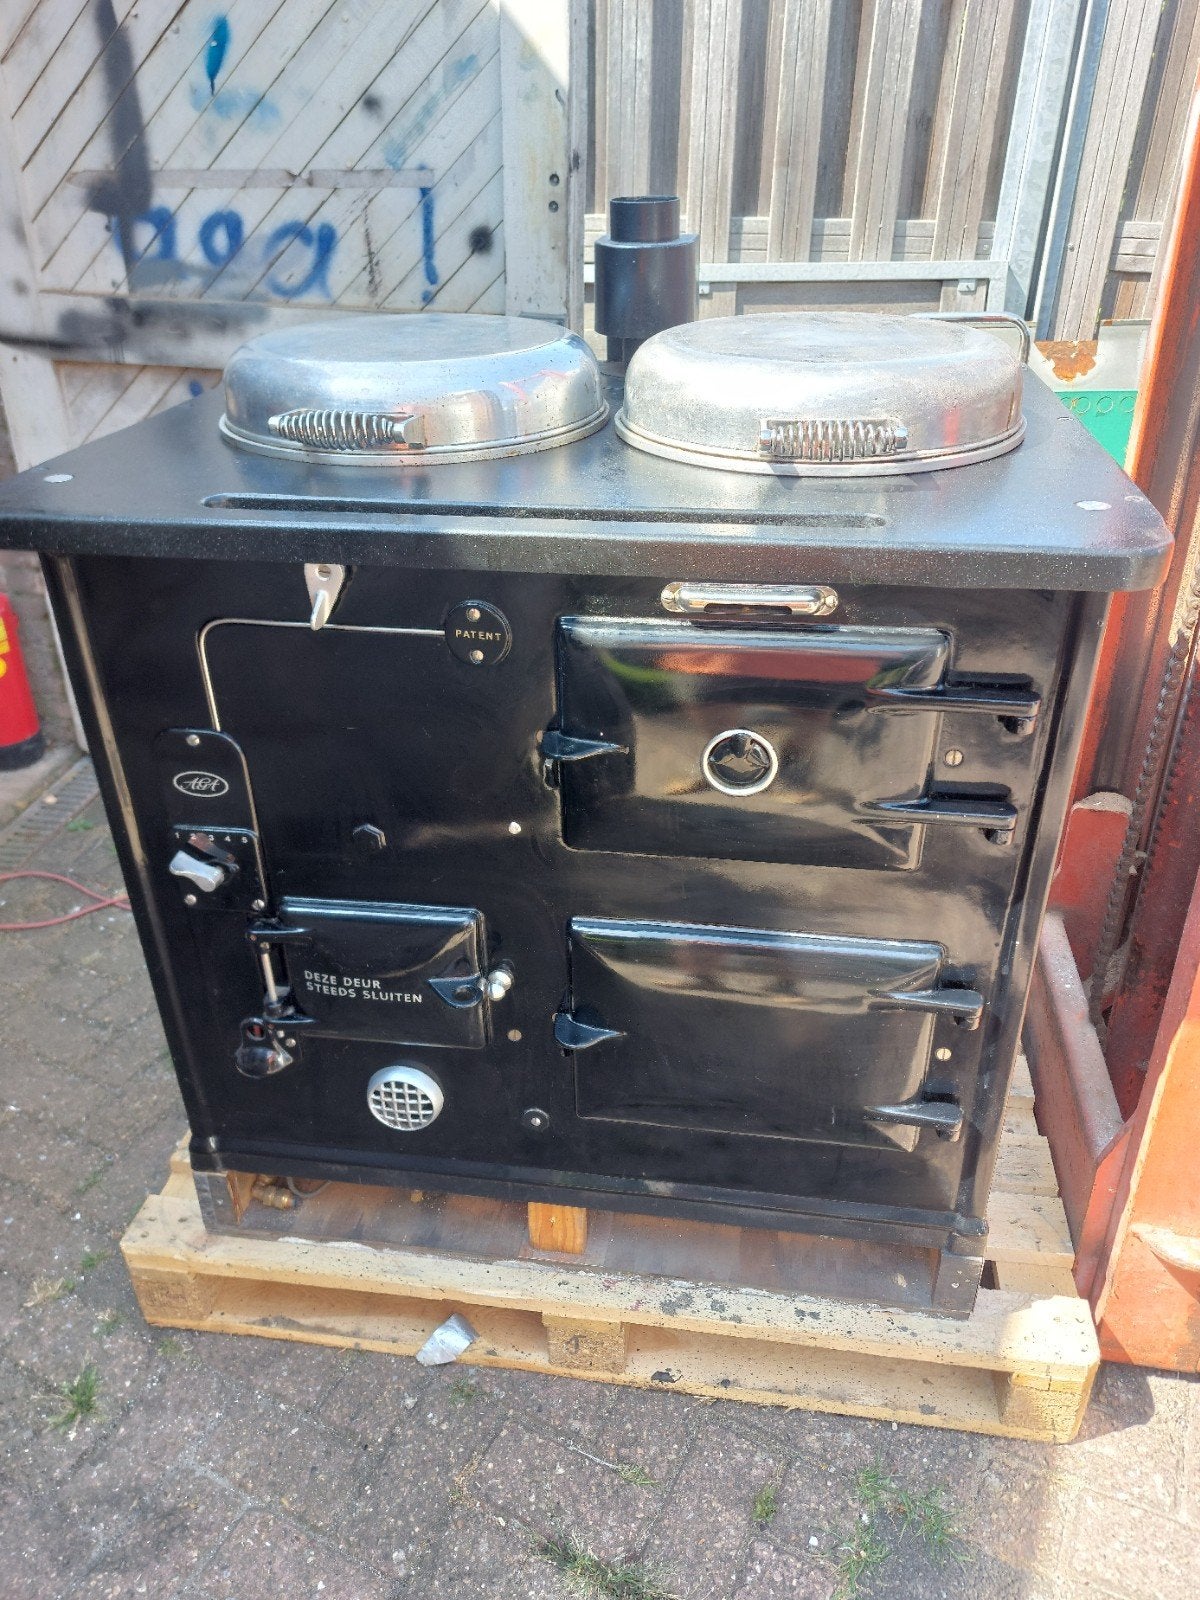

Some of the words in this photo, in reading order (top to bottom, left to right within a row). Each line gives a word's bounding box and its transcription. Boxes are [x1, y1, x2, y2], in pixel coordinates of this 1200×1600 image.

[455, 629, 502, 641] PATENT
[180, 777, 220, 791] AGA
[242, 836, 248, 844] 5
[304, 970, 337, 985] DEZE
[343, 977, 381, 989] DEUR
[306, 981, 356, 998] STEEDS
[362, 990, 423, 1003] SLUITEN
